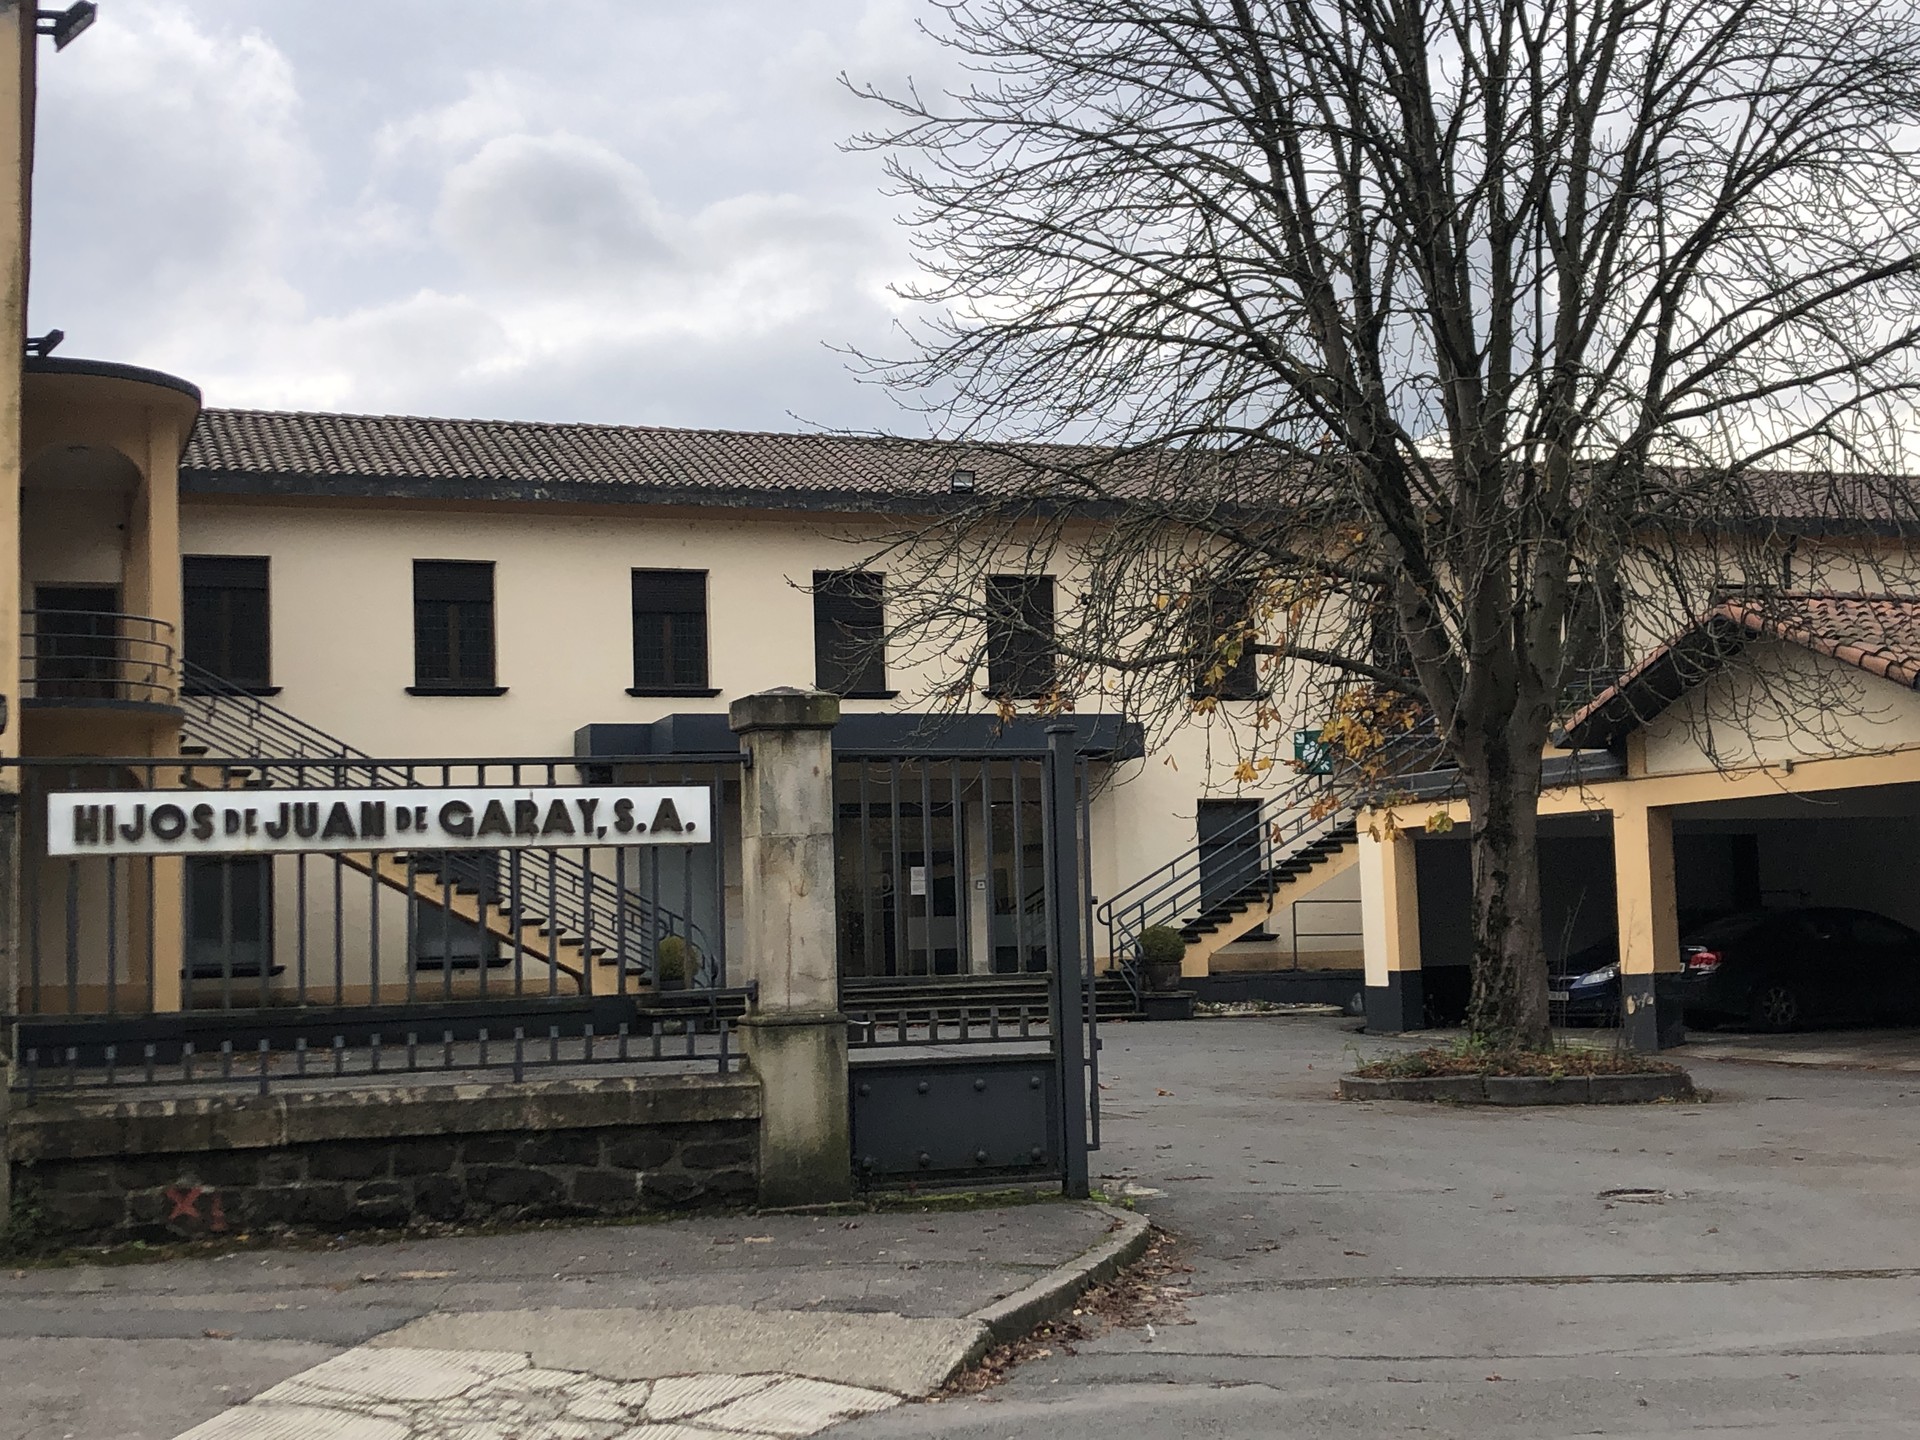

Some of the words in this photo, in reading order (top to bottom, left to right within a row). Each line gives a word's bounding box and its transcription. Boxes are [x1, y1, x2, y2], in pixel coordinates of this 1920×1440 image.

[74, 803, 215, 845] HIJOS
[224, 808, 257, 836] DE
[265, 801, 386, 840] JUAN
[396, 806, 428, 834] DE
[614, 797, 696, 834] S.A.
